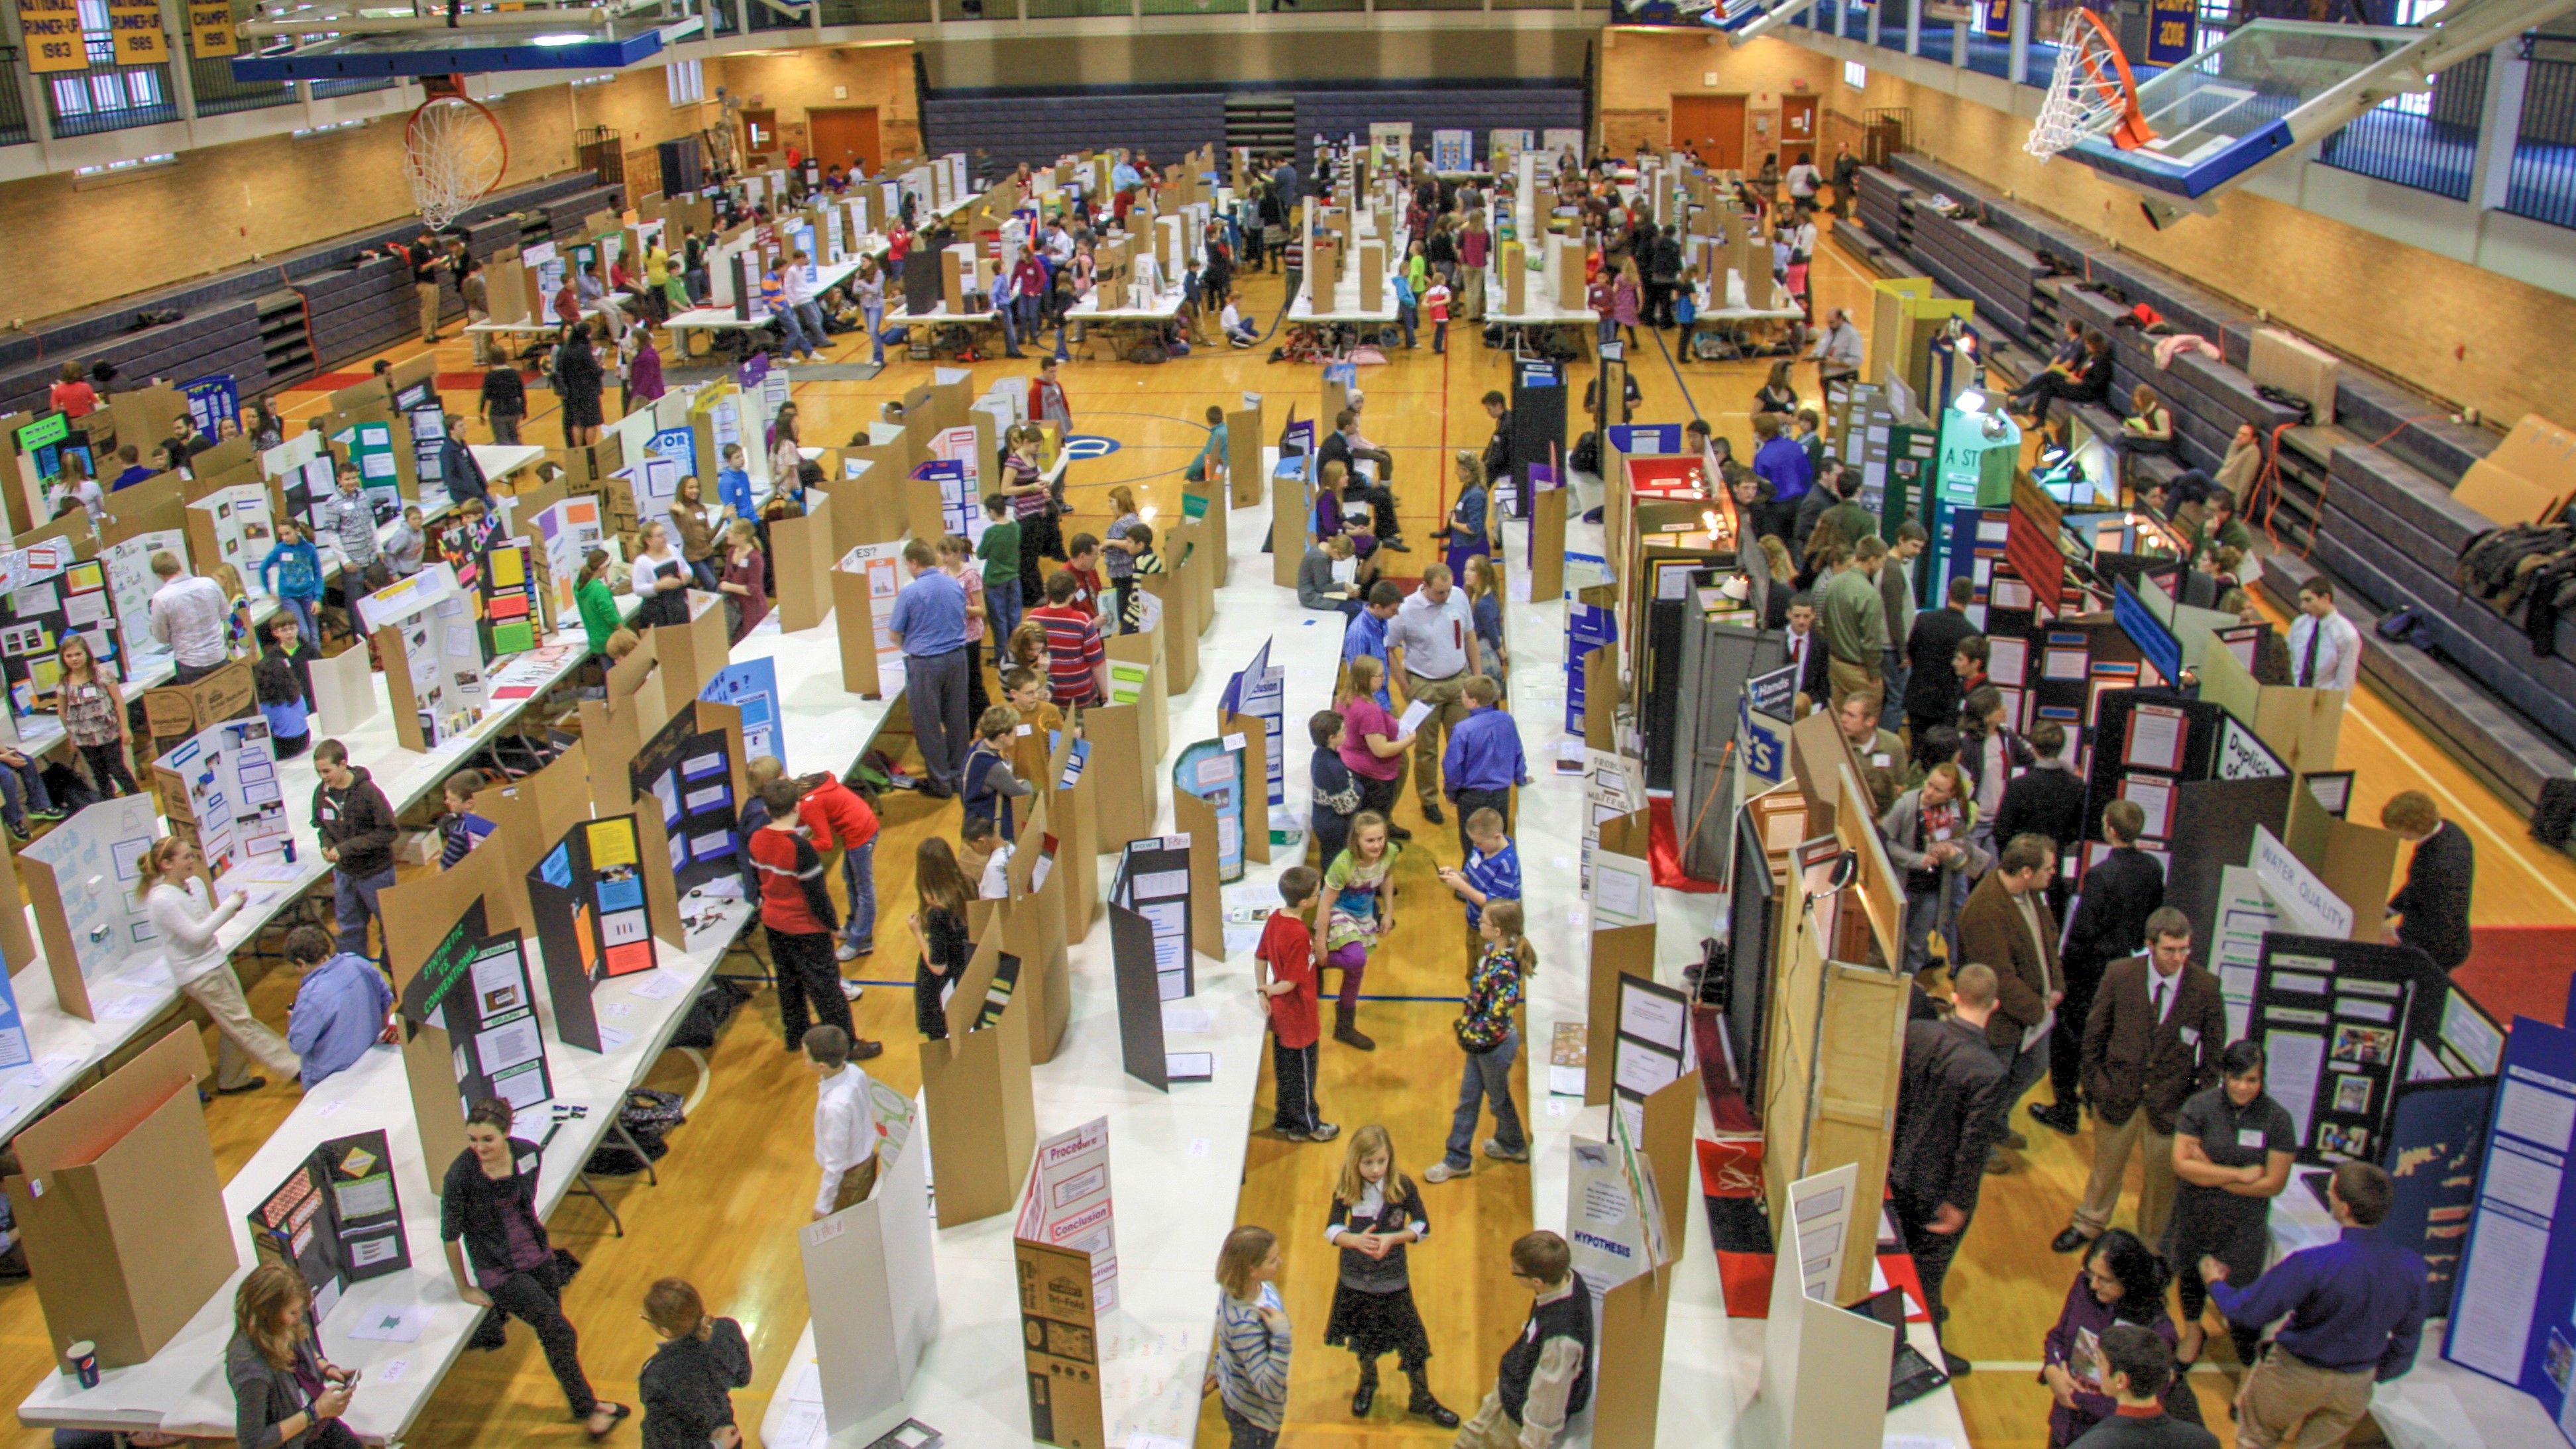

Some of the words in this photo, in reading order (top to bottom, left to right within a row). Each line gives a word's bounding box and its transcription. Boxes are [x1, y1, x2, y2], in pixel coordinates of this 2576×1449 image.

[23, 18, 79, 35] RUNNER-UP
[111, 14, 160, 30] RUNNER-UP
[2261, 842, 2295, 887] WATER
[2298, 881, 2345, 930] QUALITY
[423, 922, 464, 981] SYNTHETIC
[478, 942, 514, 958] TERIALS
[423, 943, 478, 1014] CONVENTIONAL
[491, 1012, 520, 1026] GRAPH
[494, 1061, 537, 1080] CONCLUSION
[1050, 1136, 1097, 1161] Procedure
[1054, 1207, 1107, 1238] Conclusion
[1574, 1230, 1631, 1258] HYPOTHESIS
